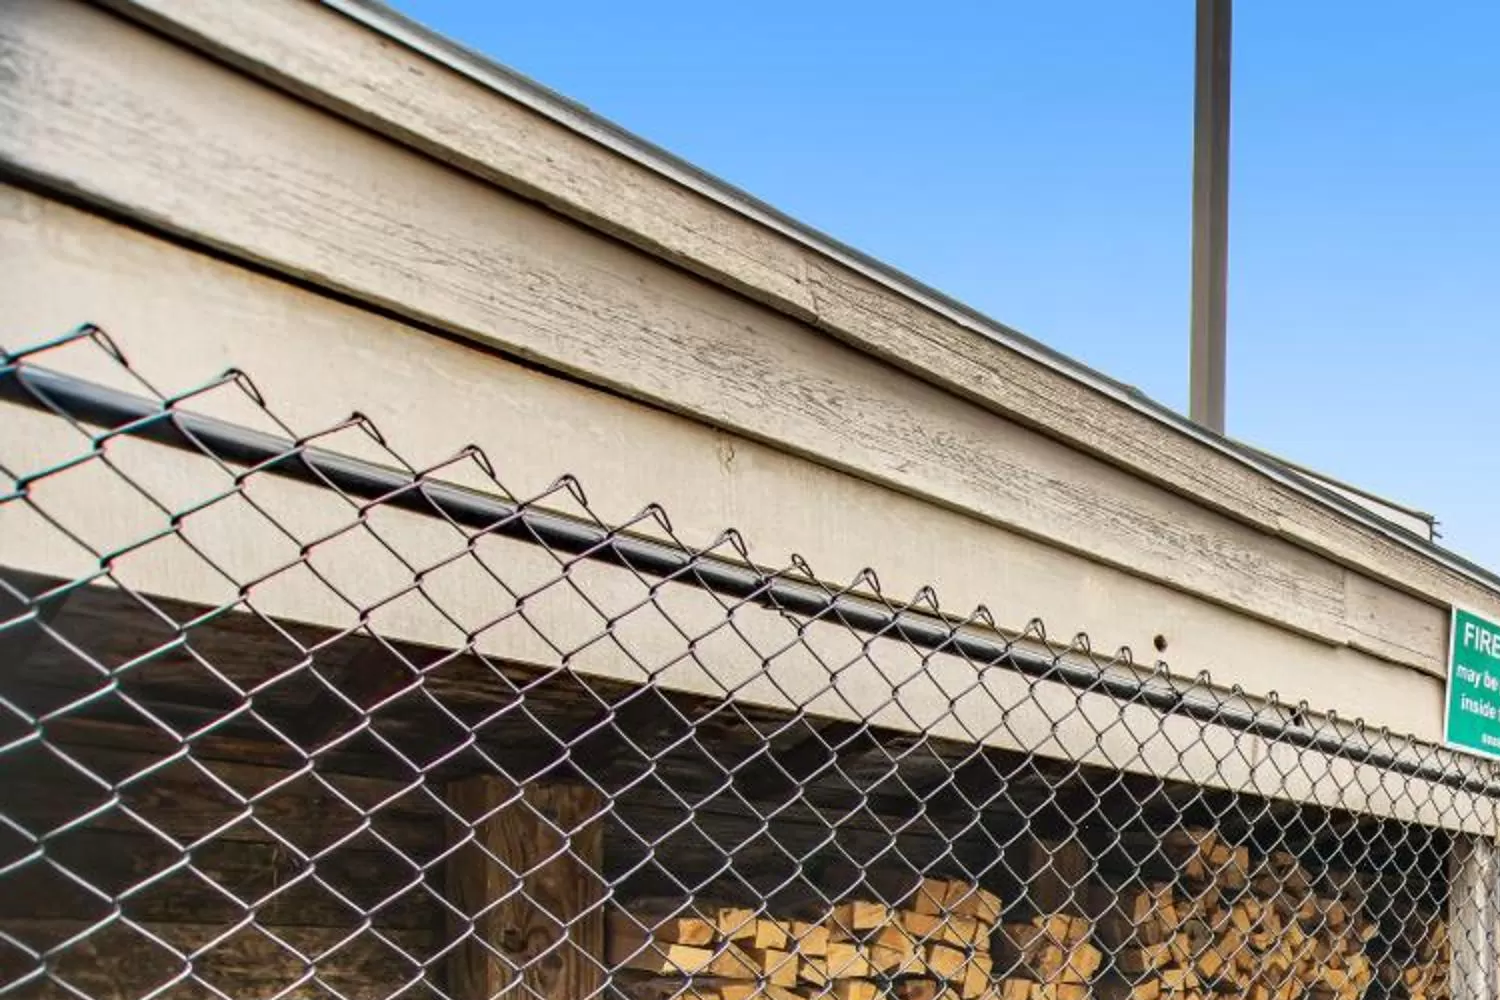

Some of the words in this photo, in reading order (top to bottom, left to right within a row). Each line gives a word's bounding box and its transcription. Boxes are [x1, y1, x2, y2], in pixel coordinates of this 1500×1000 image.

[1456, 664, 1482, 688] may
[1483, 670, 1498, 691] be
[1461, 693, 1496, 719] inside
